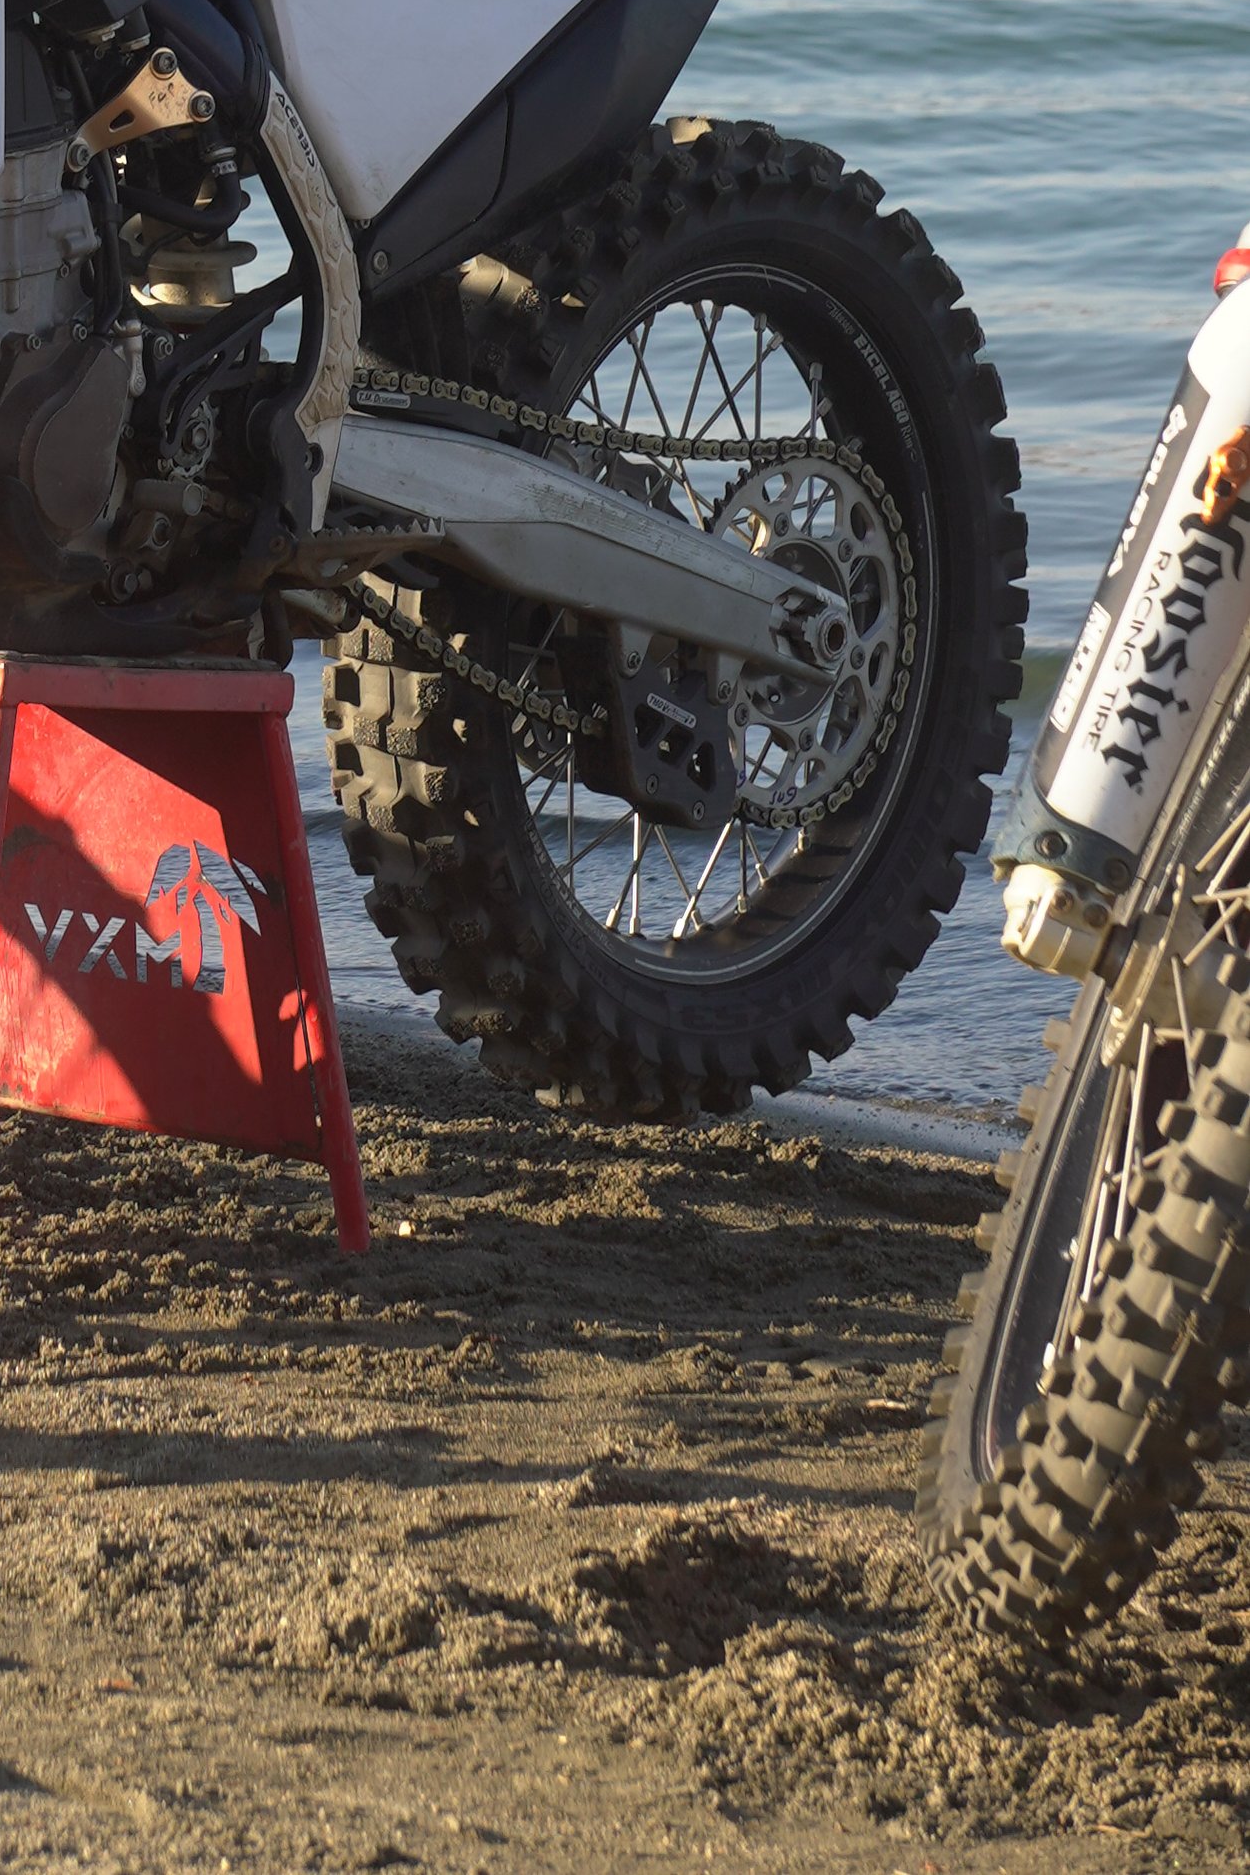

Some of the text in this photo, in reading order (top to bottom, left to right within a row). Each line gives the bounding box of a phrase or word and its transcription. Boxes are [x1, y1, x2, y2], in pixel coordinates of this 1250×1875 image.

[275, 92, 315, 167] ACERBIS
[854, 333, 891, 390] EXCEL
[1082, 552, 1172, 753] RACING TIRE
